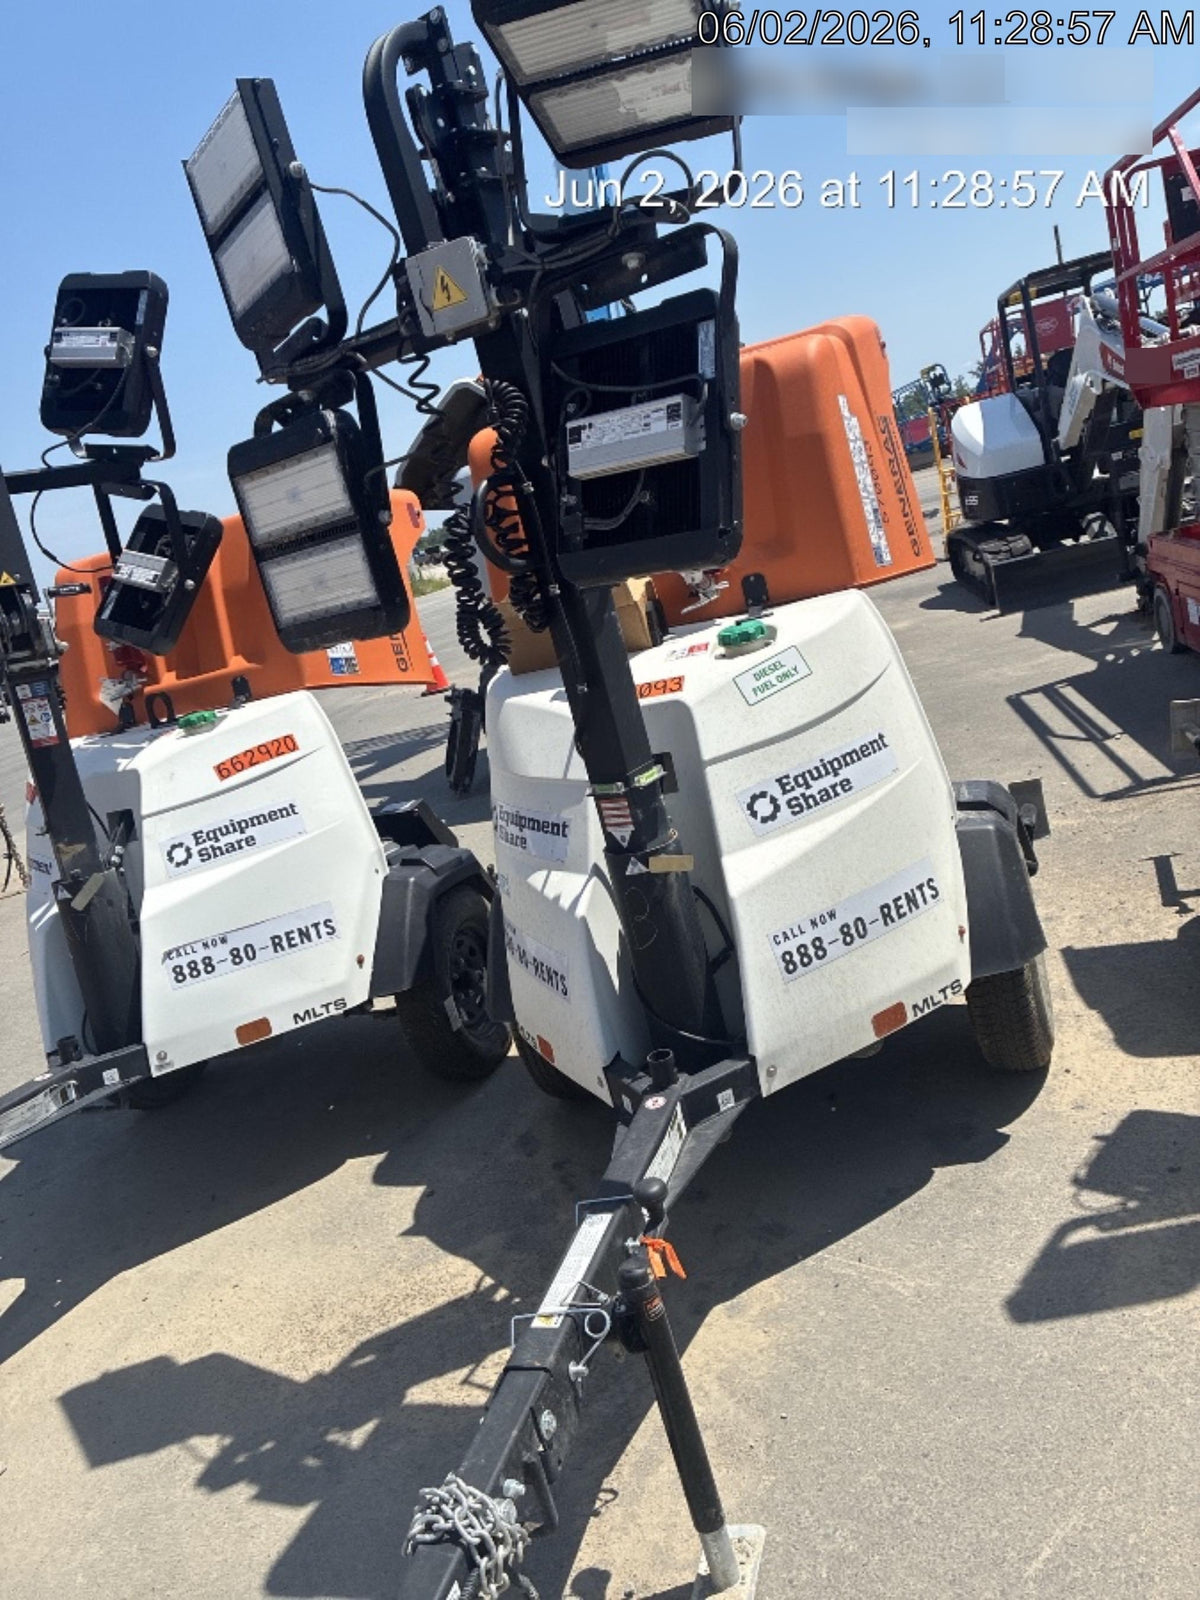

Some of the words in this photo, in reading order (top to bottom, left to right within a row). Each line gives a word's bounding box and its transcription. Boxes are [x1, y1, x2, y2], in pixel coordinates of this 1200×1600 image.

[751, 679, 779, 697] FUEL
[776, 665, 800, 683] ONLY
[753, 660, 787, 682] DIESEL
[216, 735, 296, 779] 662920
[774, 732, 889, 795] Equipment
[785, 777, 854, 817] Share
[191, 802, 299, 847] Equipment
[498, 805, 570, 838] Equipment
[197, 834, 257, 863] Share
[772, 924, 806, 946] CALL
[809, 908, 838, 931] NOW
[780, 877, 940, 975] 888-80-RENTS
[166, 945, 198, 961] CALL
[201, 934, 229, 950] NOW
[171, 918, 337, 984] 888-80-RENTS
[292, 997, 348, 1025] MLTS
[911, 979, 963, 1018] MLTS
